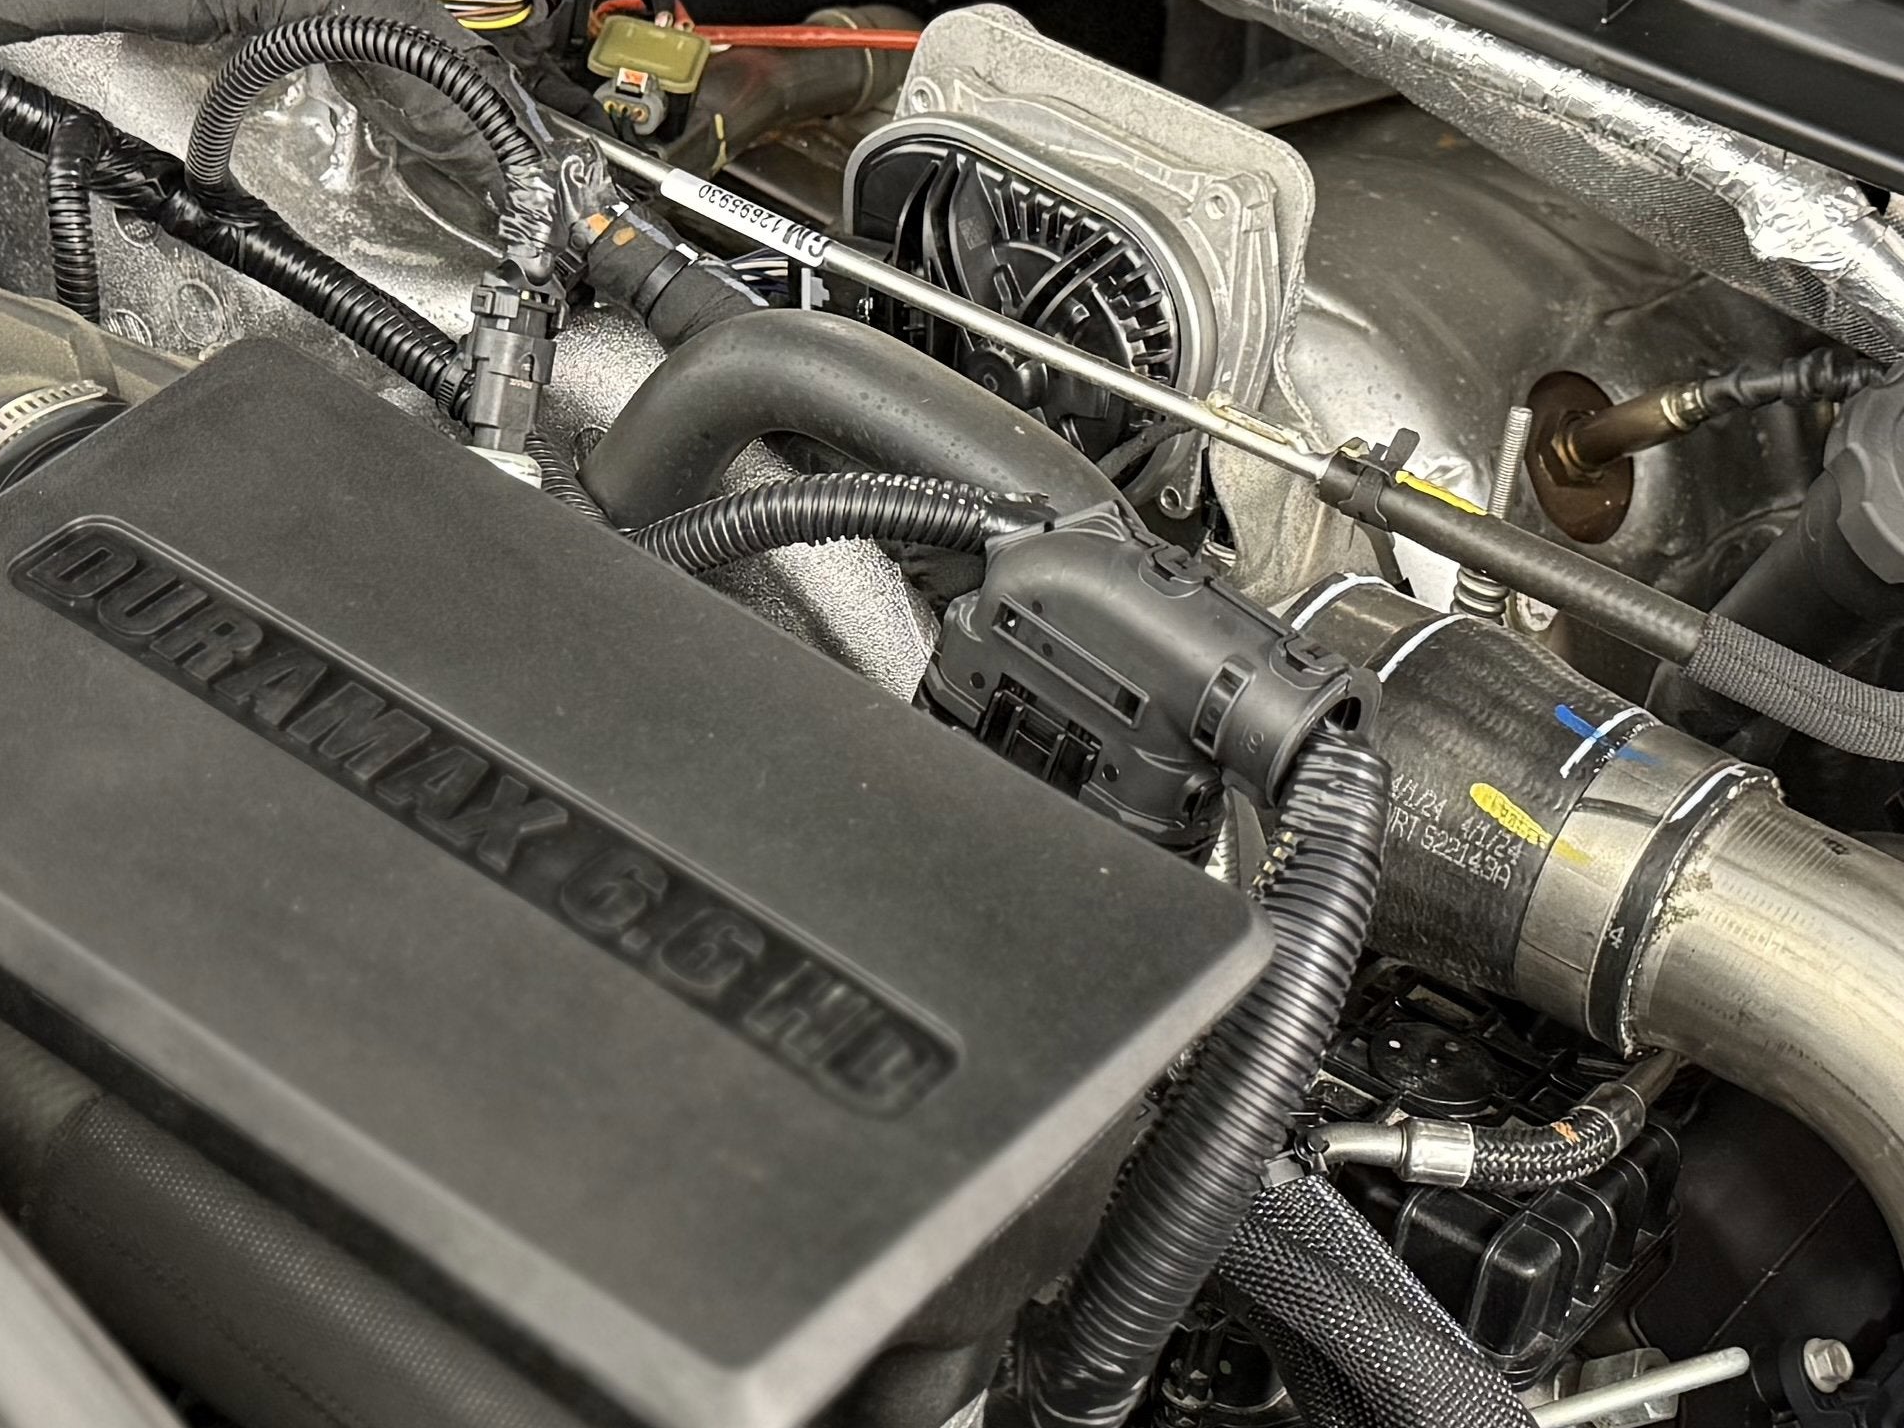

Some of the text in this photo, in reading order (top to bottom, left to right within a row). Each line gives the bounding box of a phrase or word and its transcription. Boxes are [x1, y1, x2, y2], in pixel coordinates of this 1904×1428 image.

[698, 184, 832, 258] GM 12695930
[27, 543, 934, 1115] DURAMAX 6.6 HD
